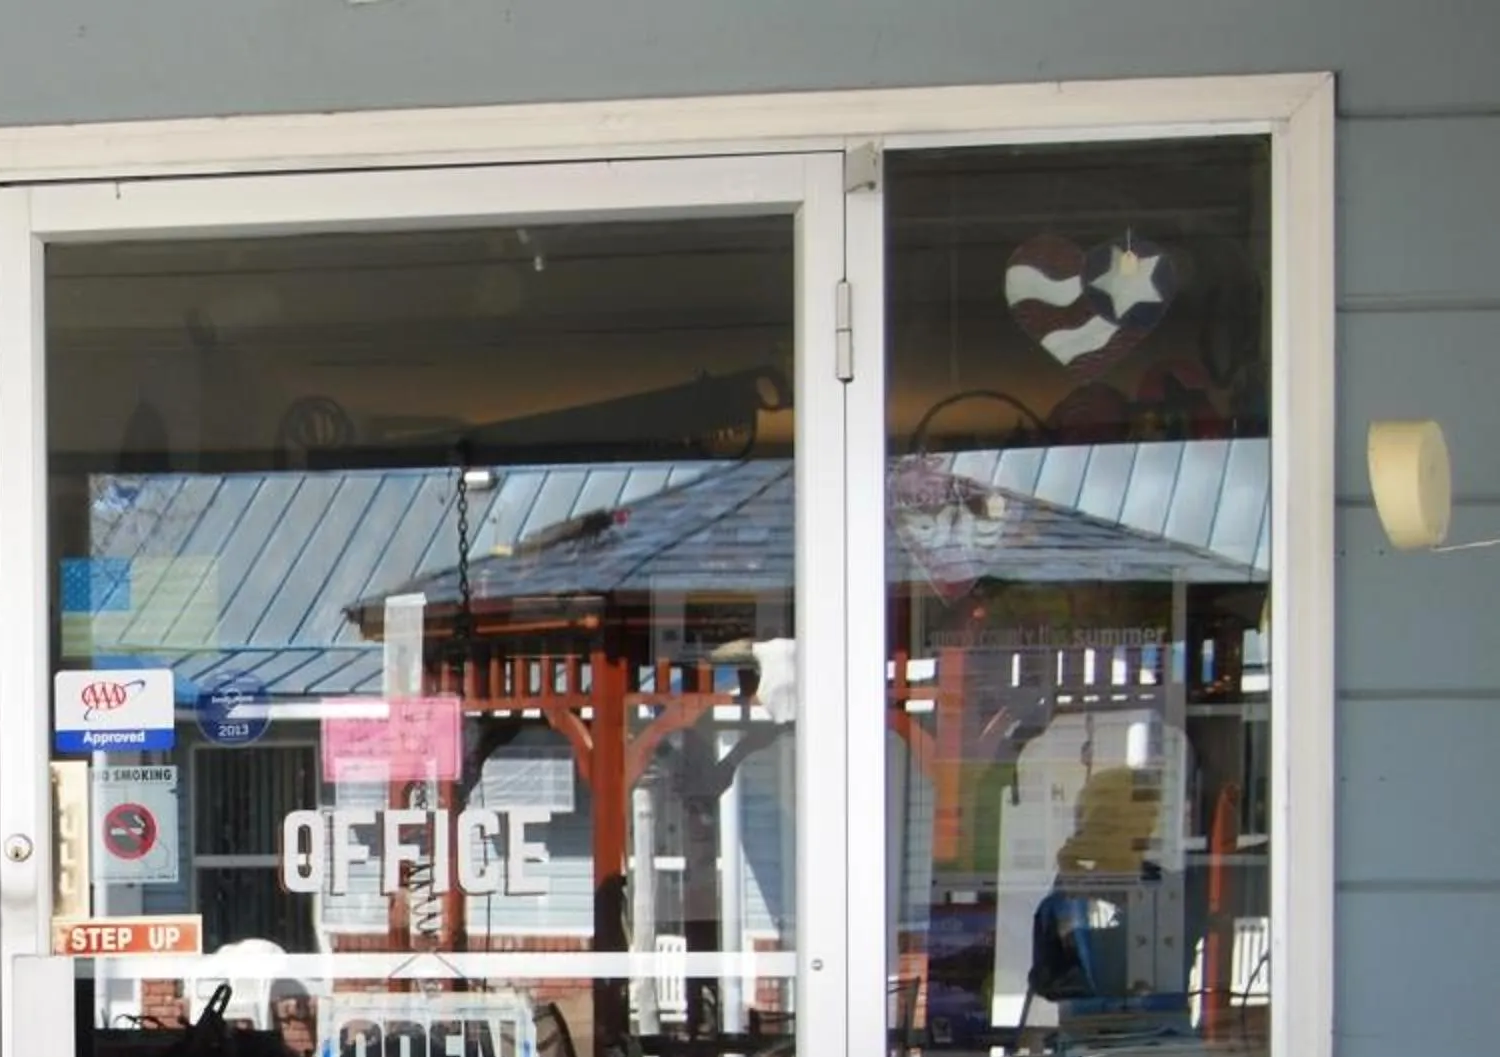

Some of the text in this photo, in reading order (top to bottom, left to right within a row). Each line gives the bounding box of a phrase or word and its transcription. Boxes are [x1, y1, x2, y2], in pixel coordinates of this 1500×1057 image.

[83, 730, 146, 746] Approved
[218, 723, 250, 737] 2013
[113, 768, 173, 781] SMOKING
[283, 808, 551, 897] OFFICE
[71, 925, 180, 951] STEP UP
